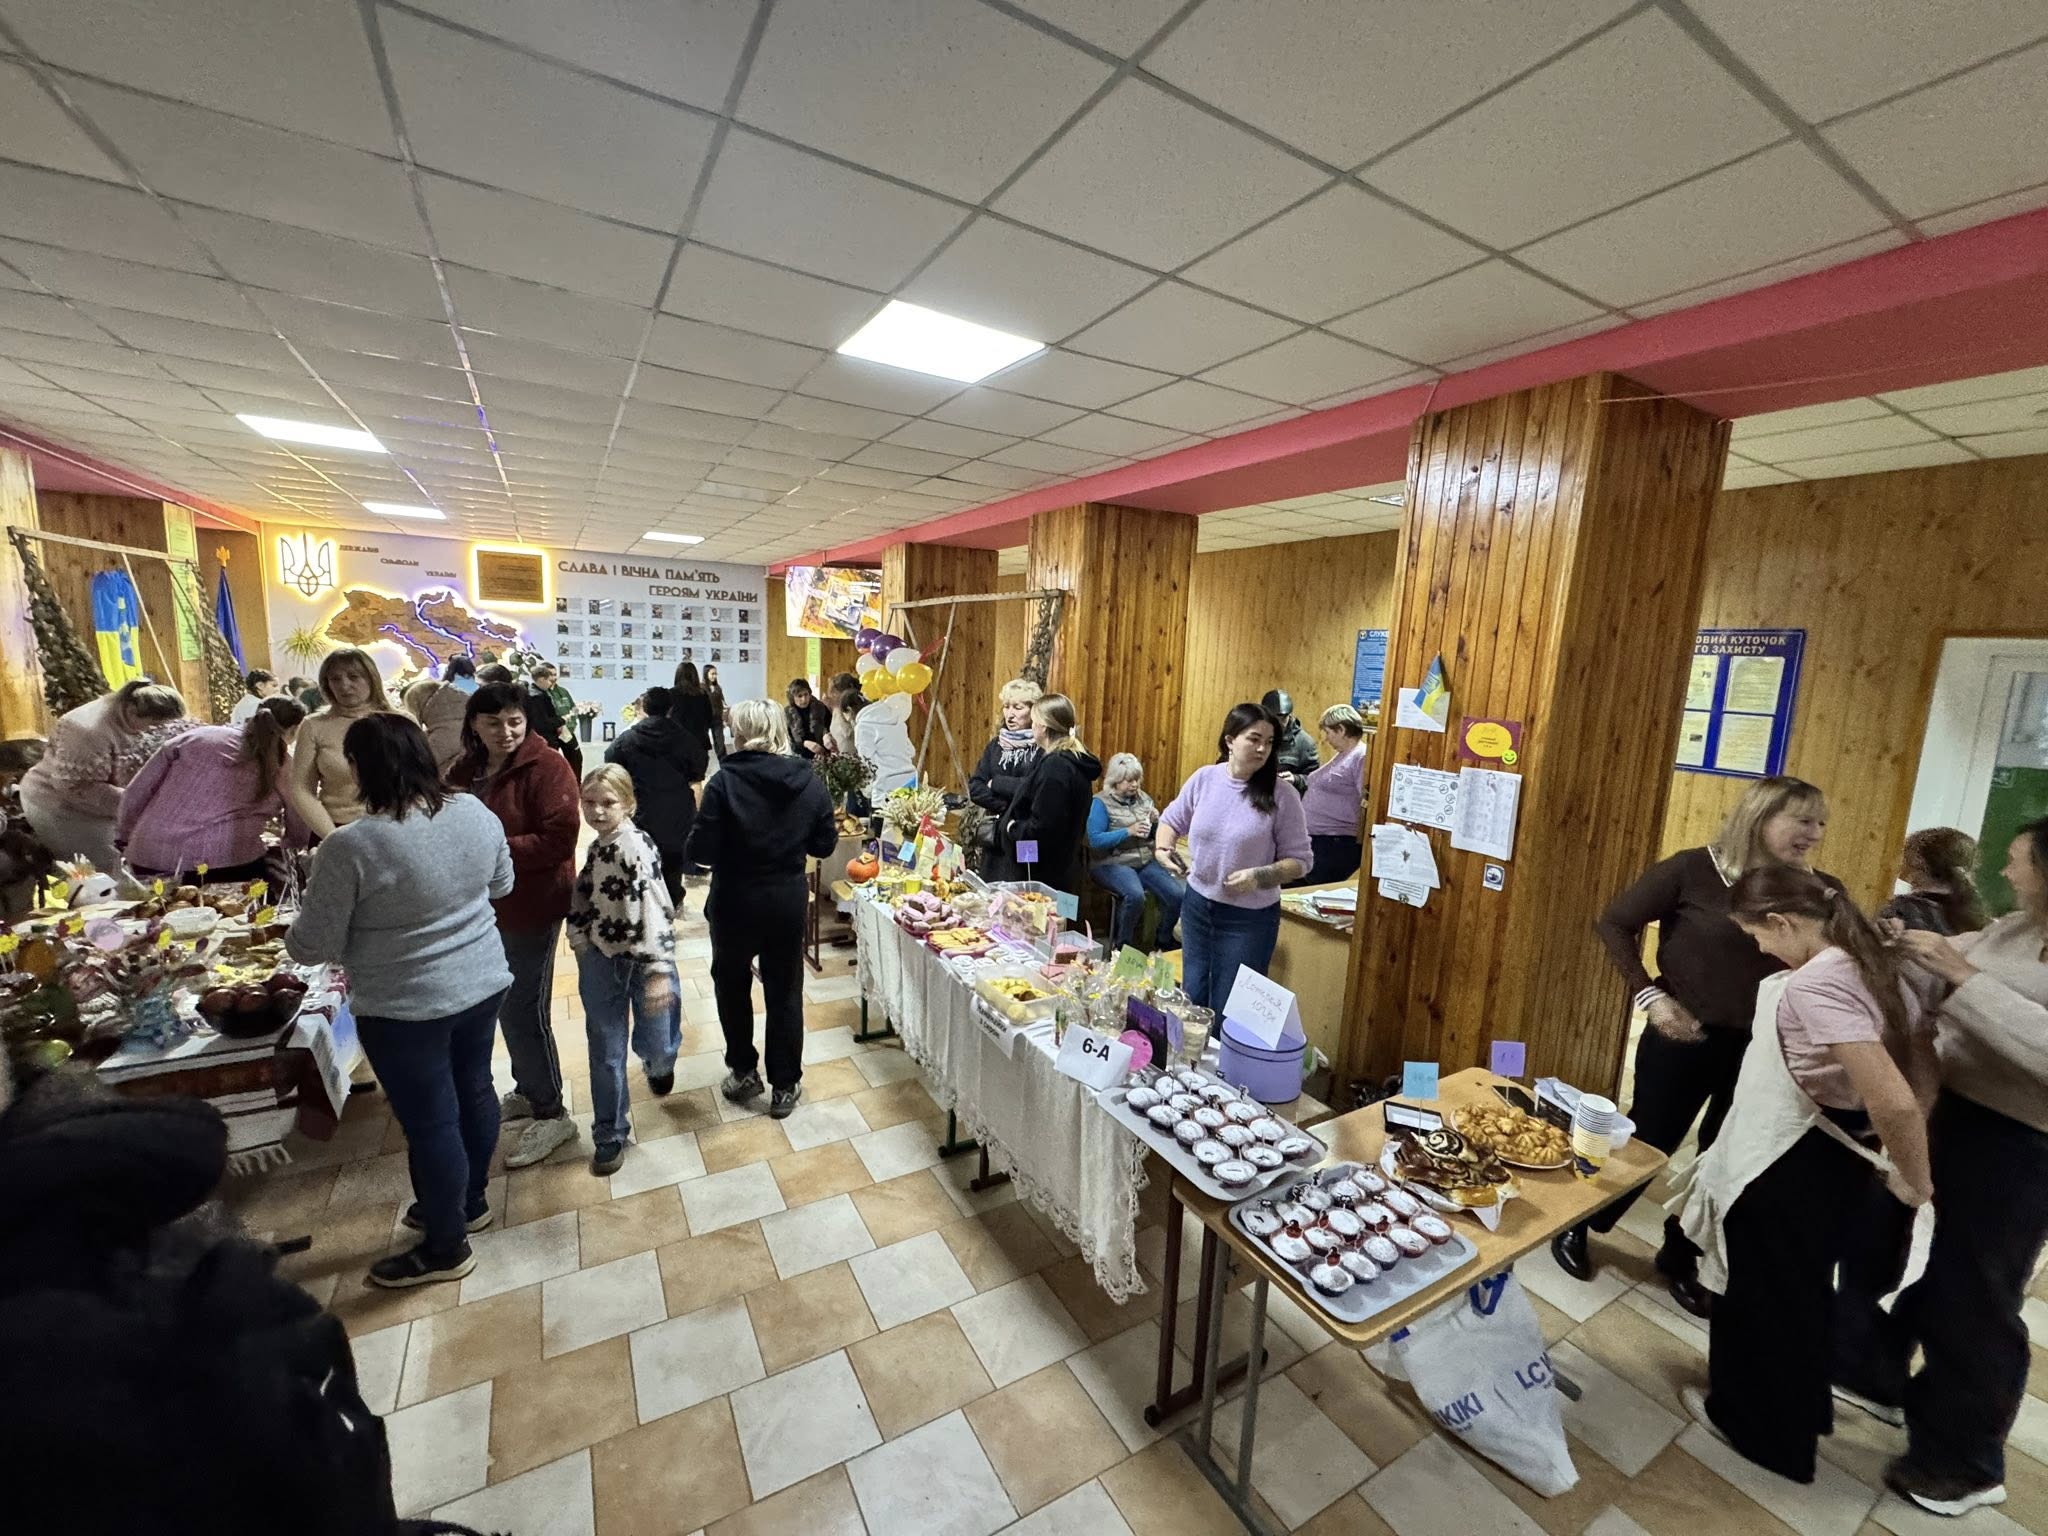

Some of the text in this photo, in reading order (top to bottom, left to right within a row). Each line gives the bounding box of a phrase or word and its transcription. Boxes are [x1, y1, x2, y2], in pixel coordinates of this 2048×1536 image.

[558, 561, 608, 575] СЛАВА
[621, 565, 660, 579] ВІЧНА
[648, 585, 758, 603] ГЕРОЯМ УКРАЇНИ
[1730, 636, 1788, 645] КУТОЧОК
[1712, 645, 1766, 655] ЗАХИСТУ
